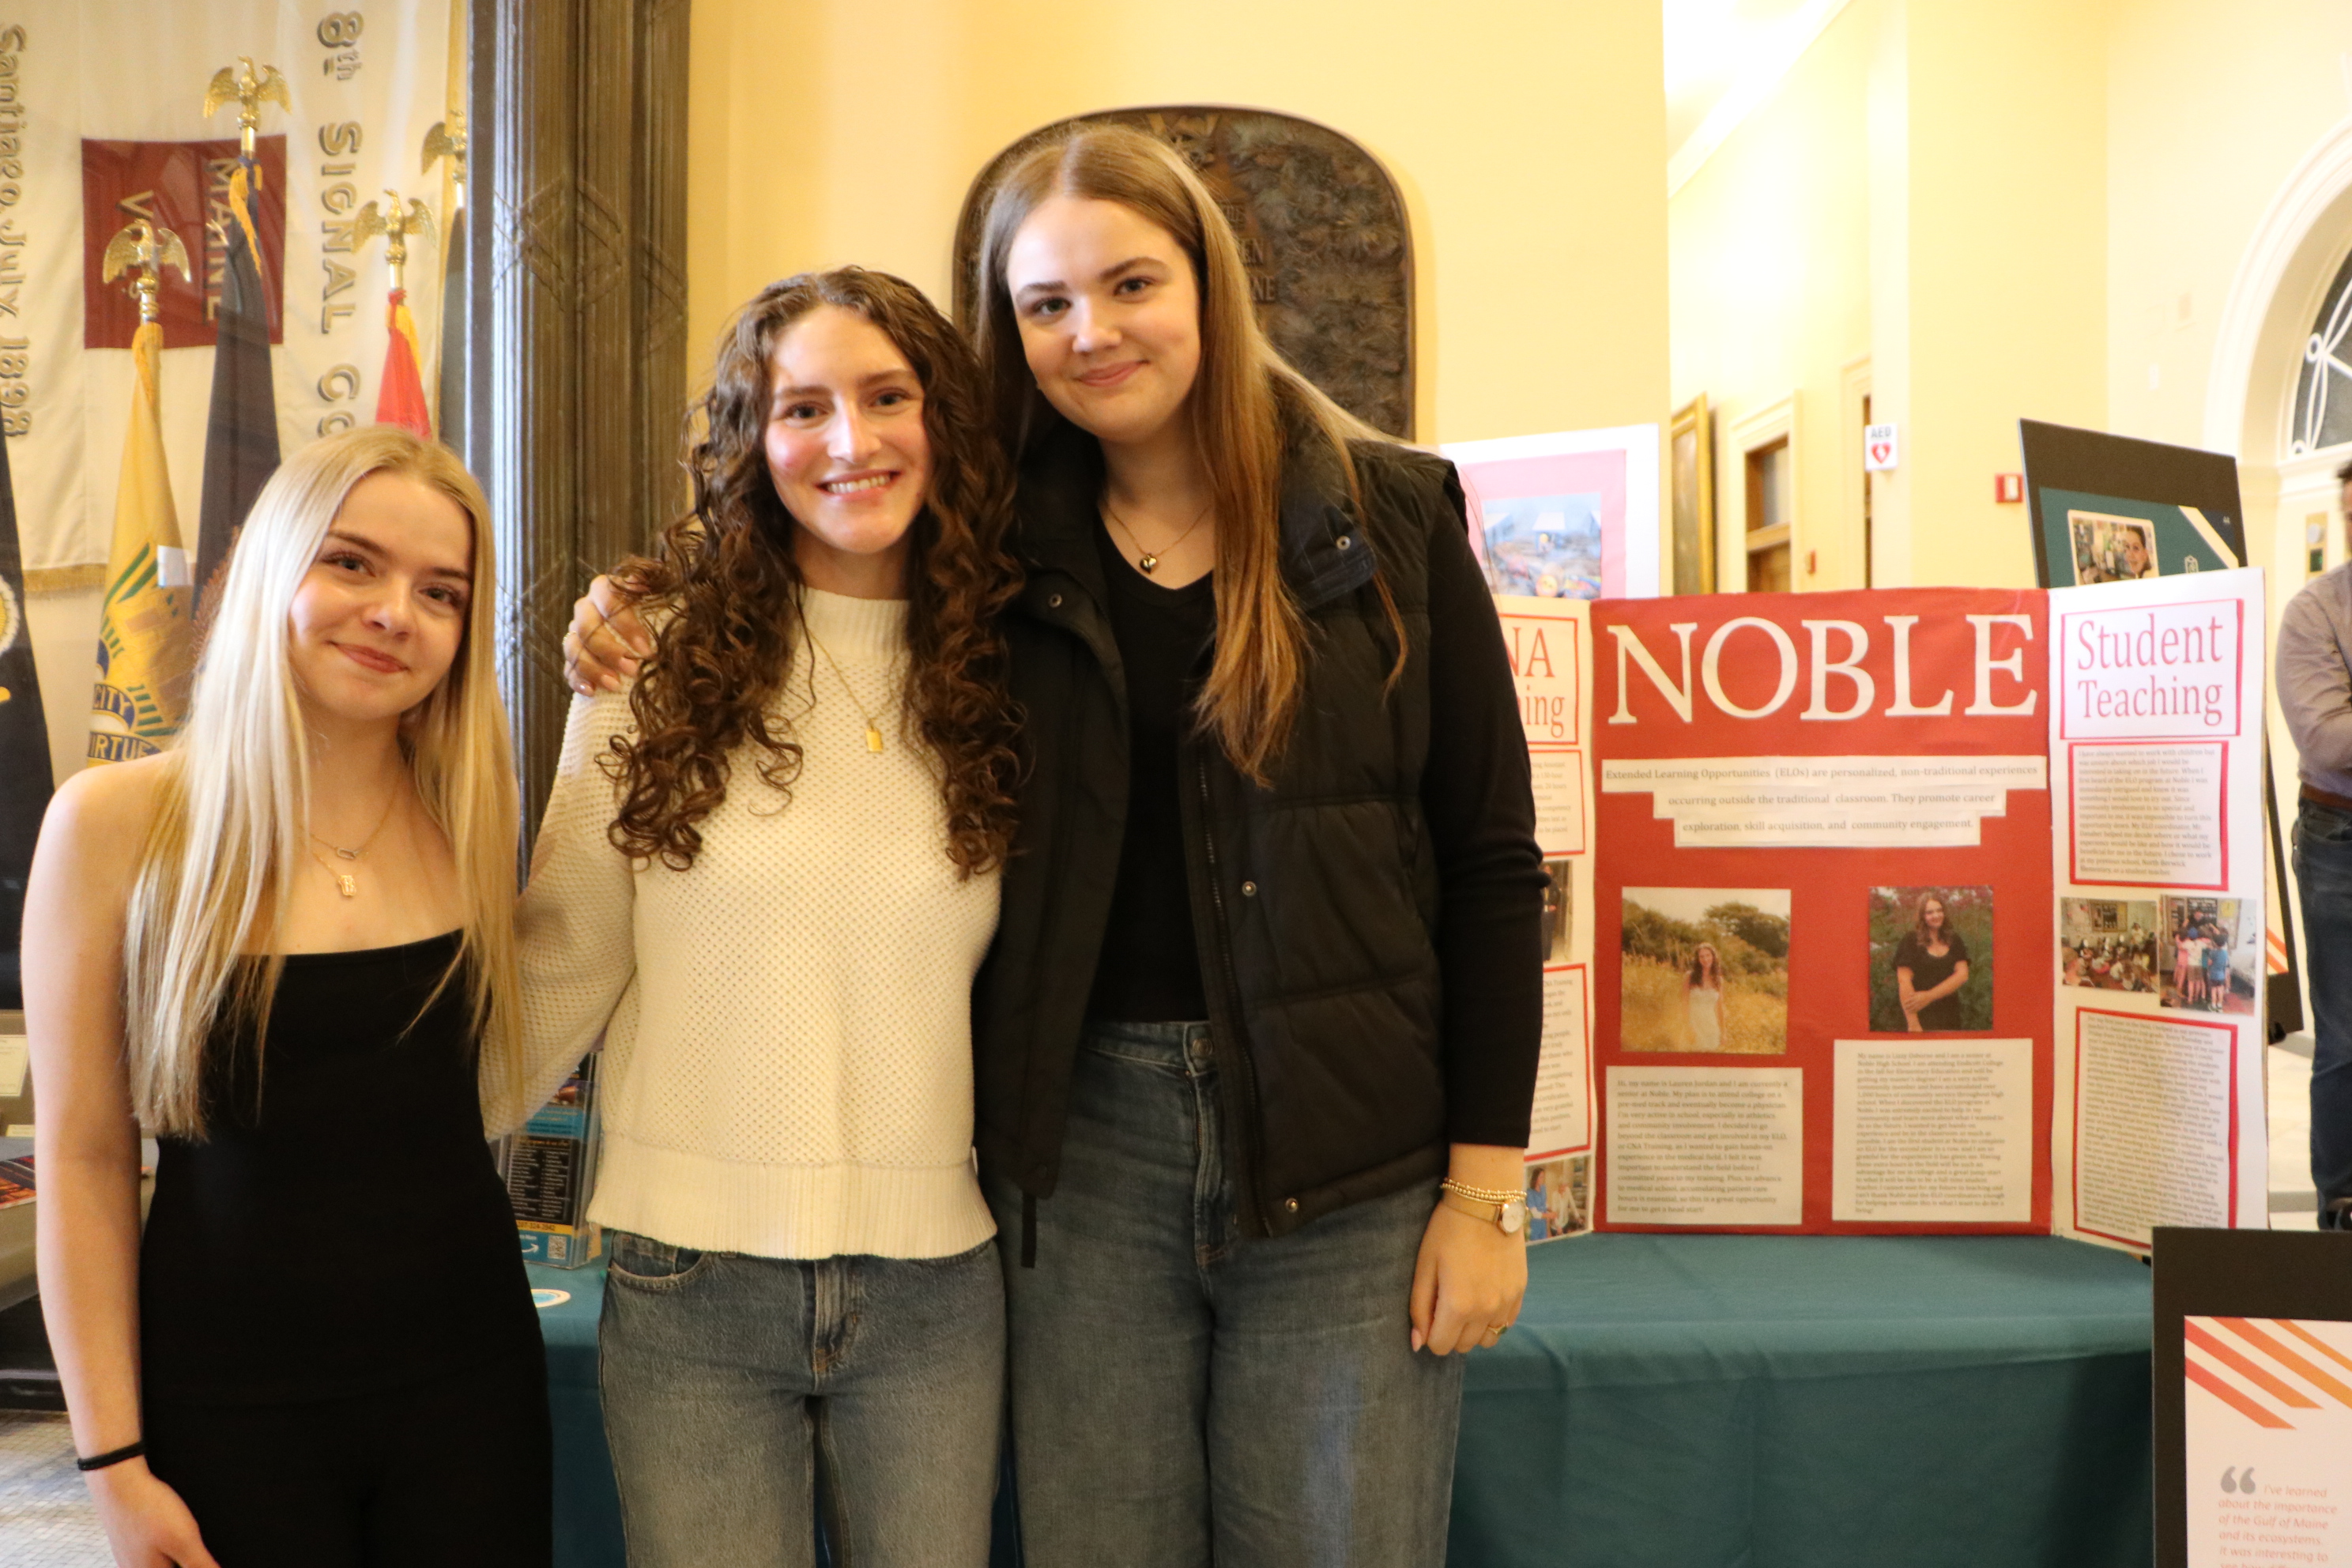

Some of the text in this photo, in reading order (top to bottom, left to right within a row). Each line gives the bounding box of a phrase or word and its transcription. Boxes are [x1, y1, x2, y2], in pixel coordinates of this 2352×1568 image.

[319, 122, 363, 334] SIGNAL
[0, 336, 32, 437] 1898
[1871, 426, 1891, 438] AED
[2078, 613, 2223, 671] Student
[1607, 613, 2038, 724] NOBLE
[2078, 675, 2223, 727] Teaching
[1606, 769, 1651, 778] Extended
[1656, 768, 1699, 781] Learning
[1701, 768, 1770, 780] Opportunities
[1775, 767, 1809, 779] (ELOs)
[1901, 766, 1975, 775] non-traditional
[1979, 765, 2037, 777] experiences
[1668, 795, 1717, 807] occurring
[1719, 795, 1755, 805] outside
[1758, 794, 1774, 805] the
[1777, 794, 1830, 804] traditional
[1835, 794, 1887, 804] classroom.
[1891, 793, 1915, 805] They
[1918, 793, 1960, 805] promote
[1745, 820, 1765, 830] skill
[1828, 820, 1847, 829] and
[1852, 820, 1906, 831] community
[1910, 819, 1973, 831] engagement.
[2264, 1484, 2327, 1498] I've learned
[2218, 1498, 2337, 1514] about the importance
[2218, 1514, 2328, 1529] of the Gulf of Maine
[2219, 1531, 2240, 1540] and
[2243, 1532, 2255, 1541] its
[2220, 1546, 2328, 1562] It was interesting to
